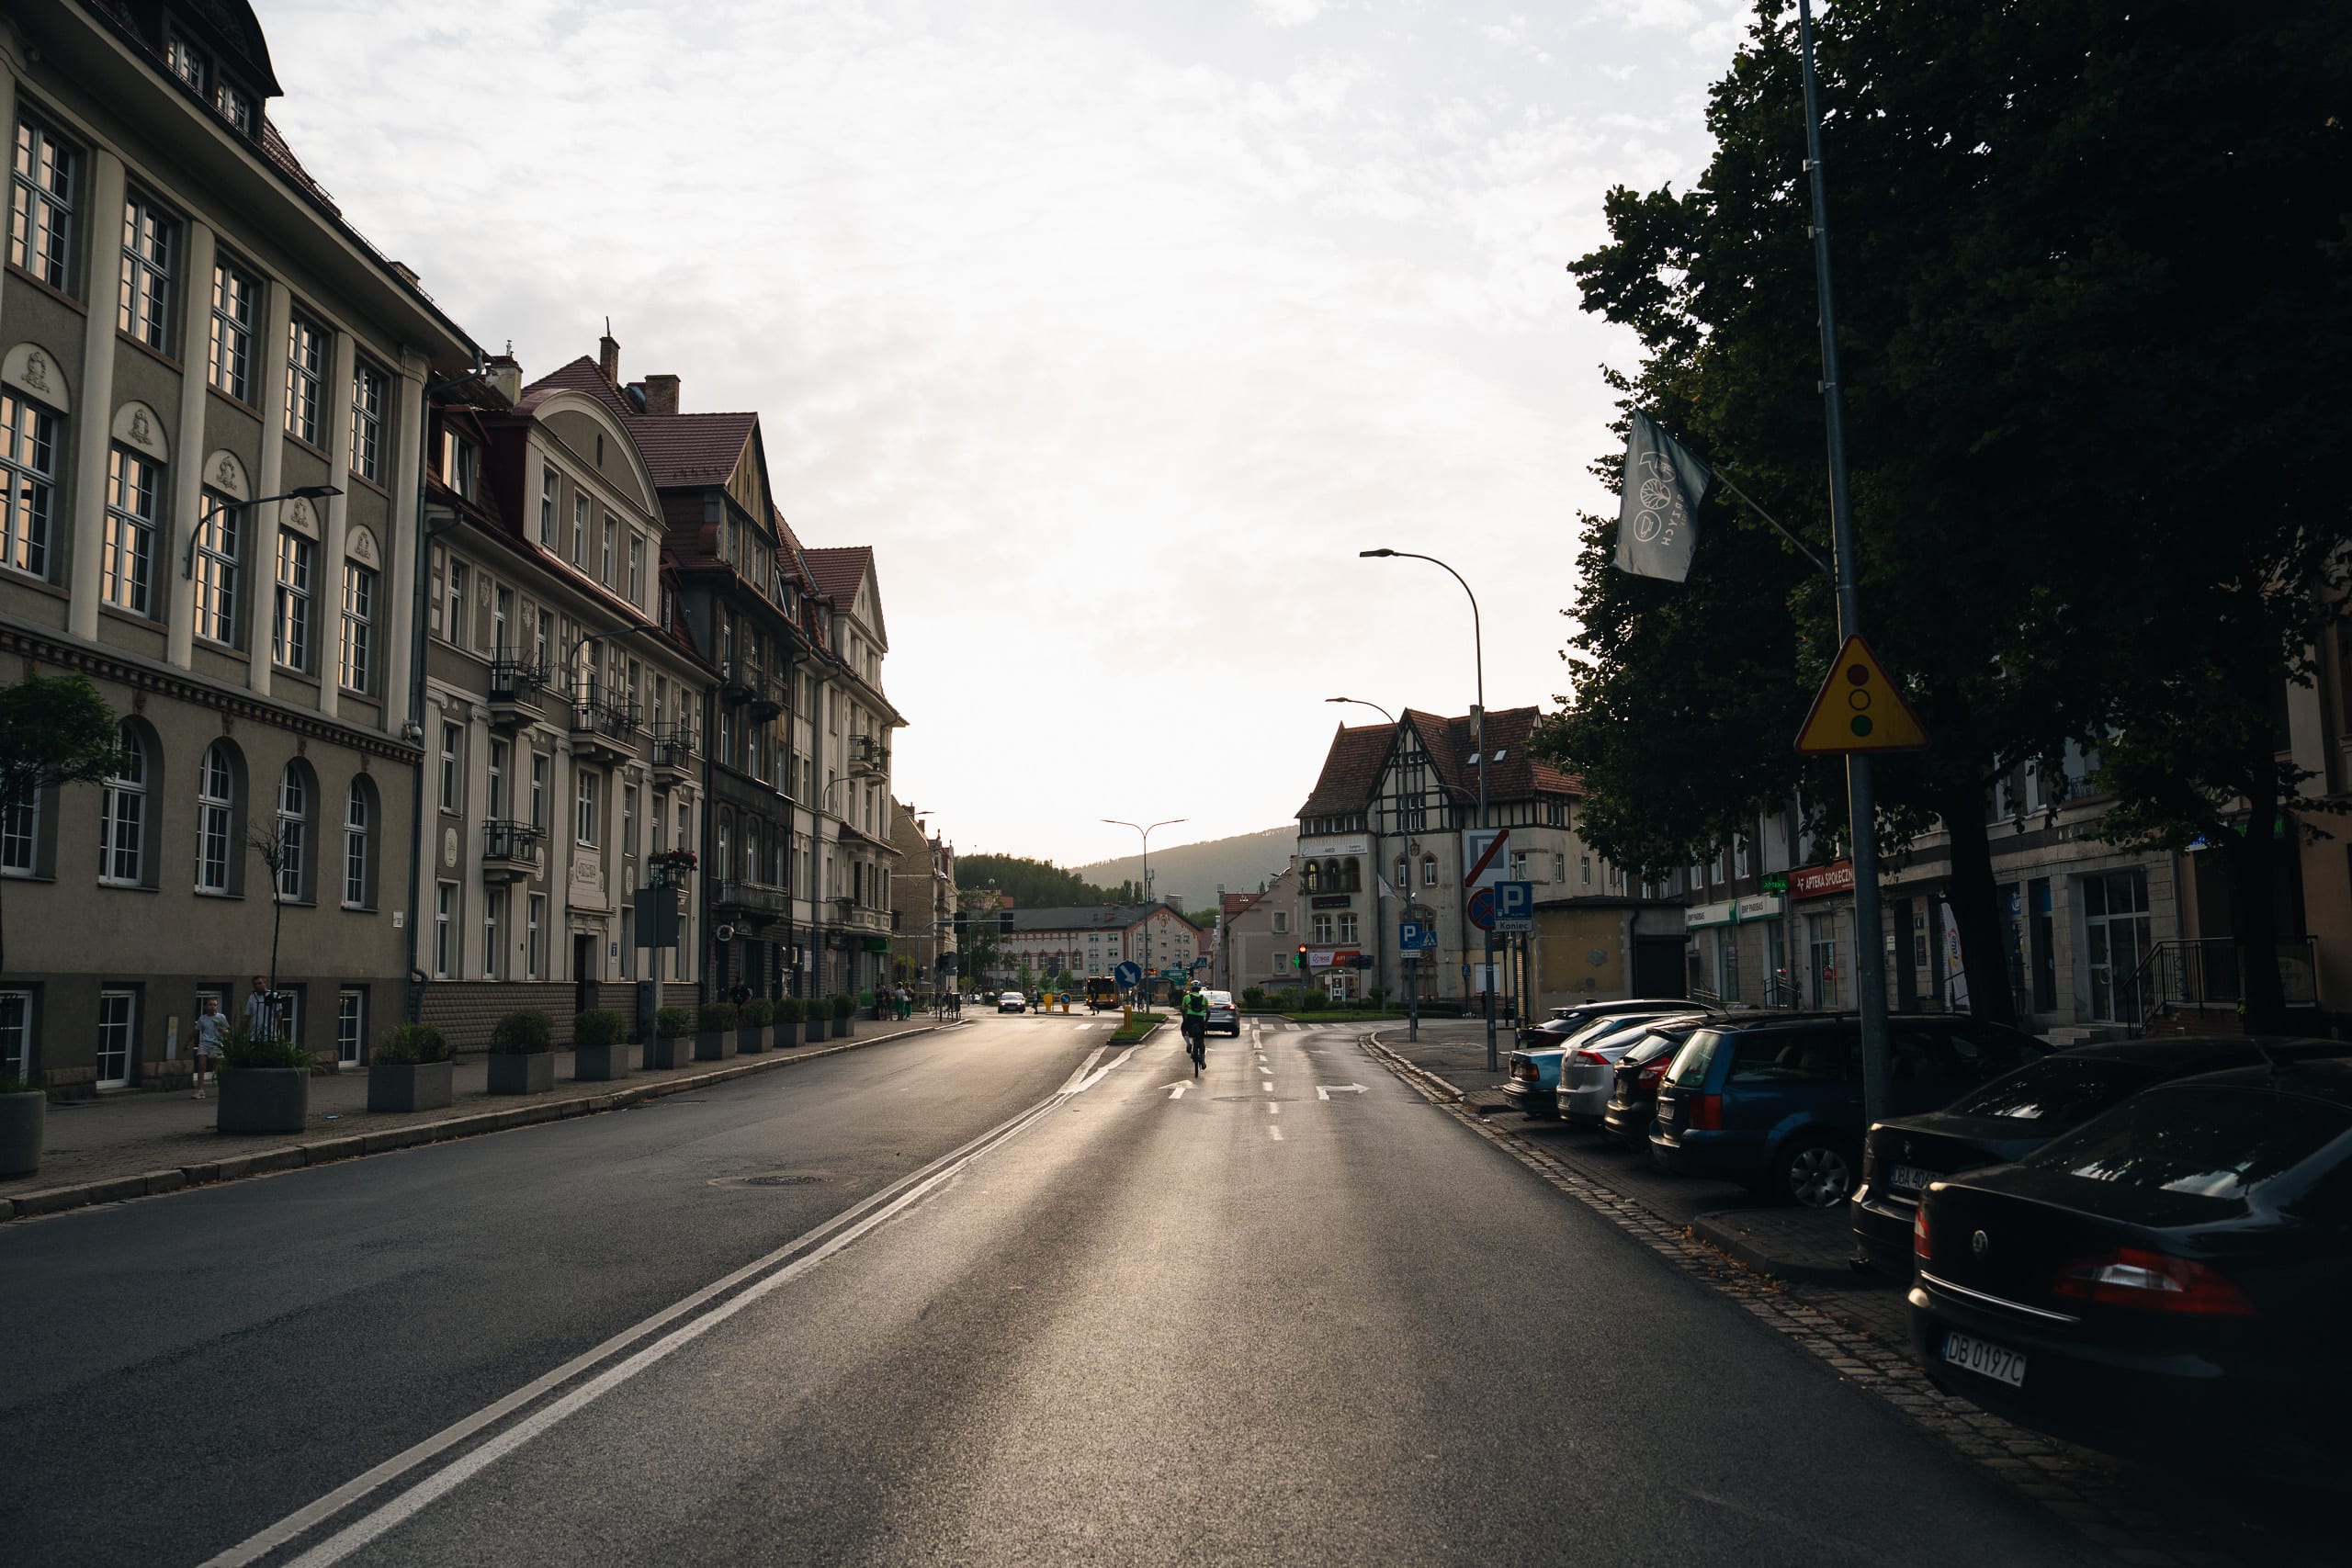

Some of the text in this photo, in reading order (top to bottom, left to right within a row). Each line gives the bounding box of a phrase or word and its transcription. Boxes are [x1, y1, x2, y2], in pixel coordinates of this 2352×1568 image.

[1764, 881, 1787, 890] APTEKA
[1805, 867, 1855, 890] APTEKA SPOŁECZN
[1502, 885, 1524, 914] P
[1748, 901, 1764, 913] PARIBAS
[1404, 925, 1417, 942] P
[1499, 921, 1529, 931] Koniec
[1949, 1334, 2024, 1382] DB 0197C
